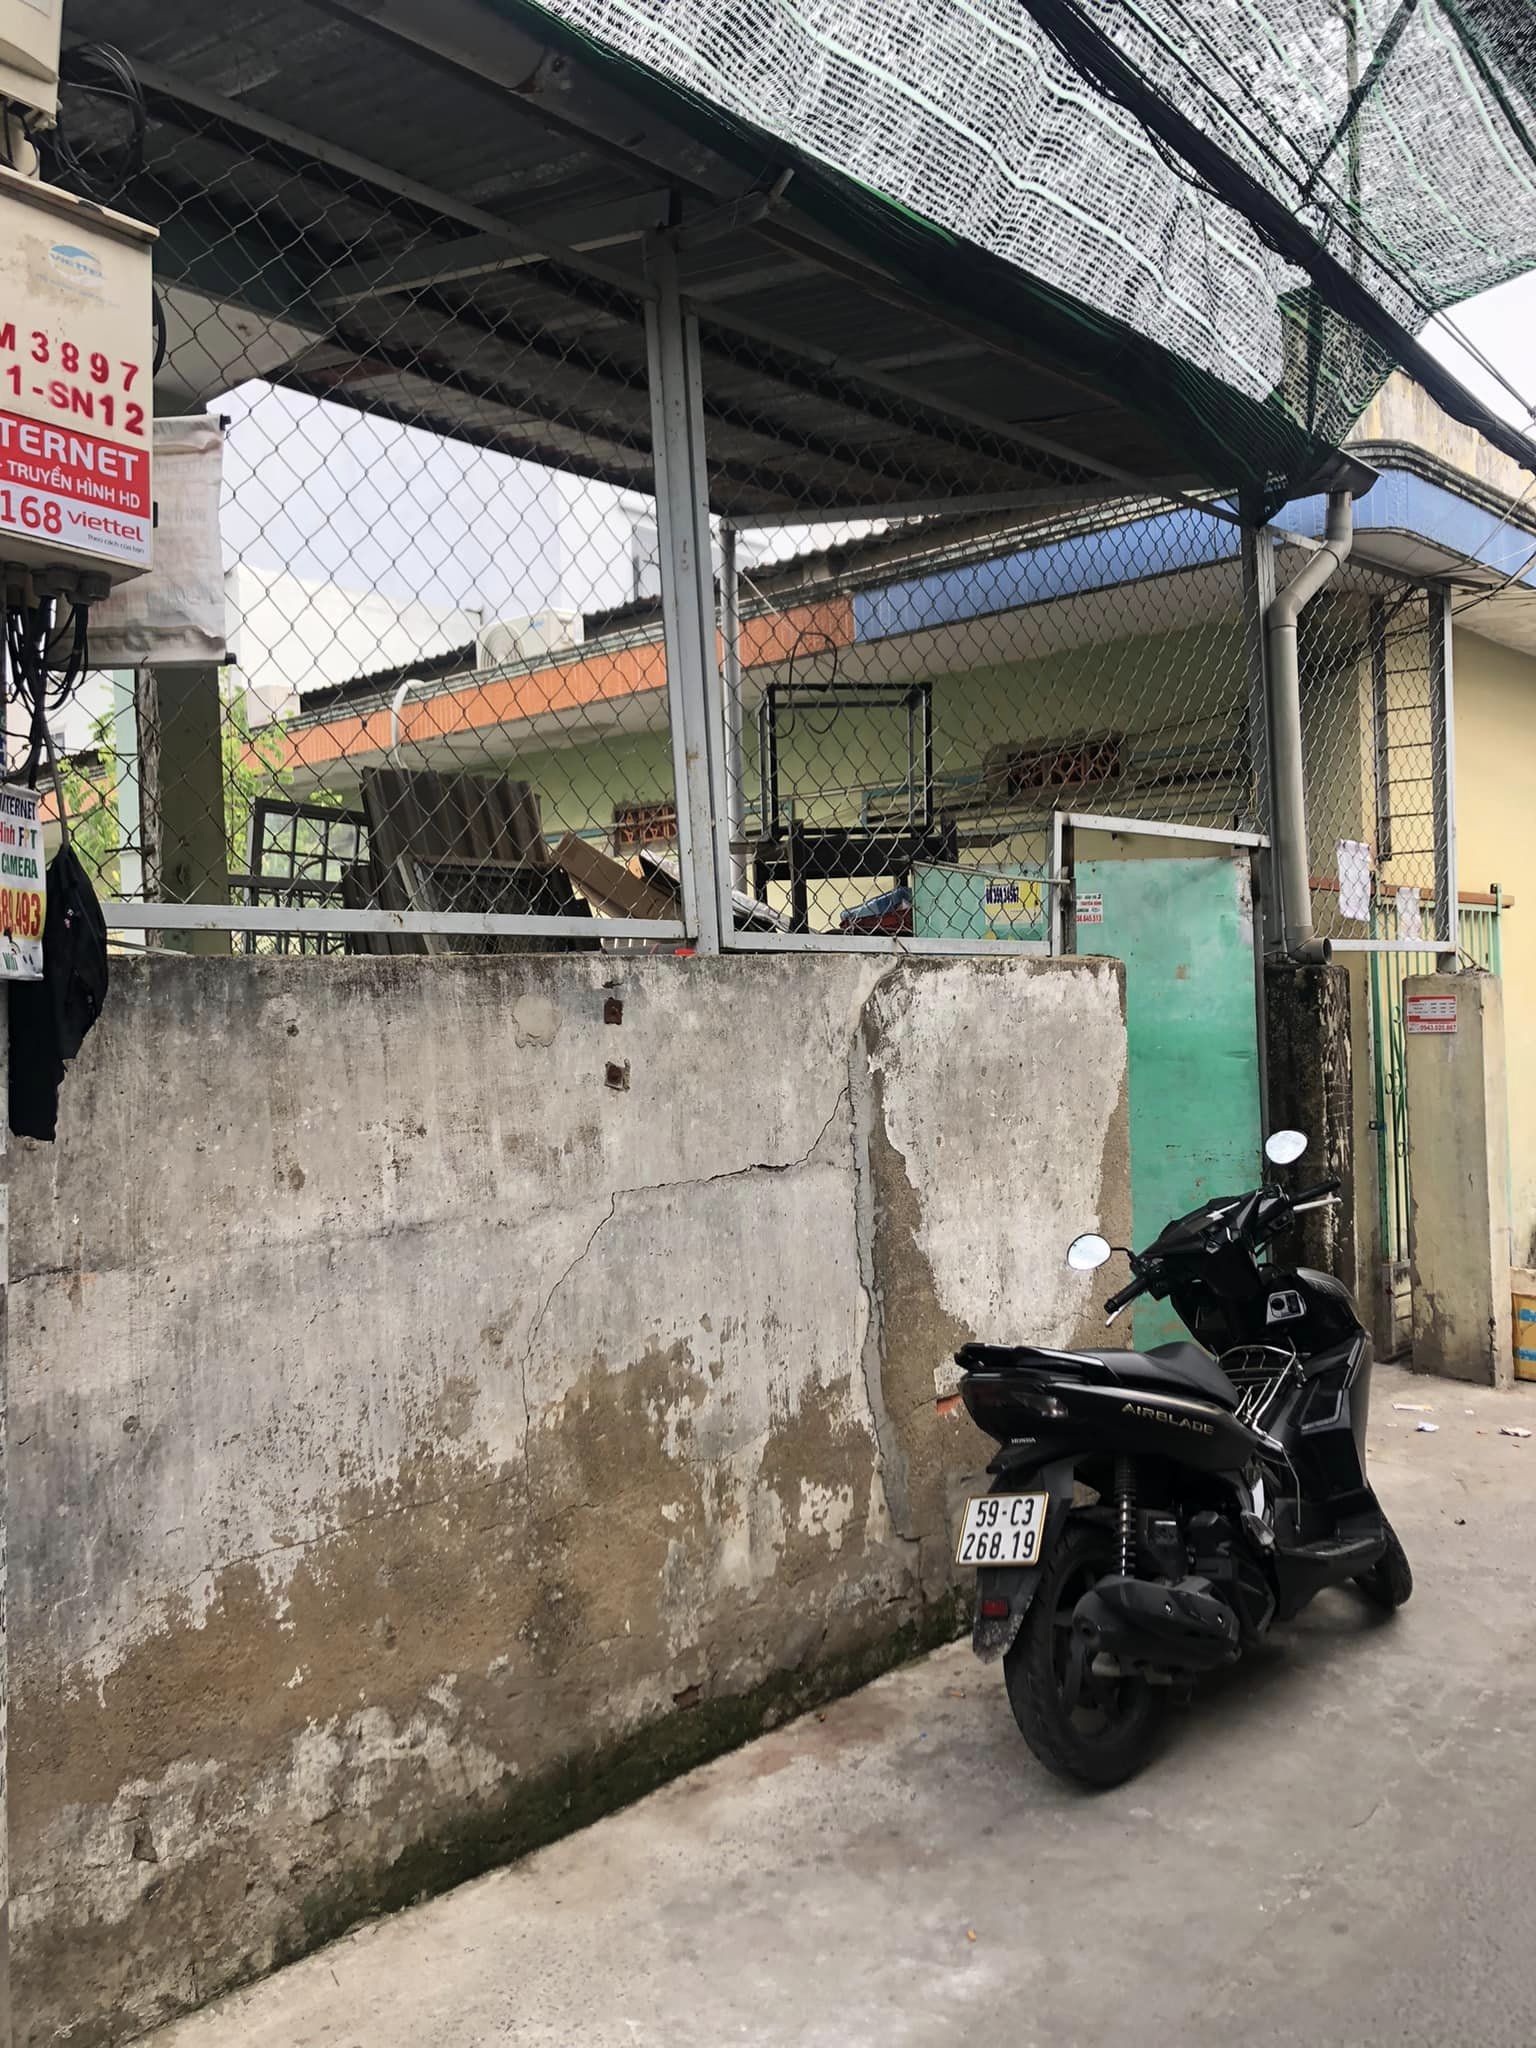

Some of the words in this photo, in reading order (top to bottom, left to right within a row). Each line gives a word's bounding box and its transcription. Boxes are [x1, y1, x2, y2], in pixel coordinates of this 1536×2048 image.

[6, 459, 72, 491] TRUYỀN
[76, 476, 115, 503] HÌNH
[119, 490, 141, 509] HD
[0, 489, 62, 534] 168
[18, 825, 37, 849] FPT
[1, 852, 38, 879] CAMERA
[1121, 1402, 1214, 1435] AIRBLADE
[975, 1498, 1034, 1528] 59-C3
[962, 1531, 1036, 1561] 268.19
